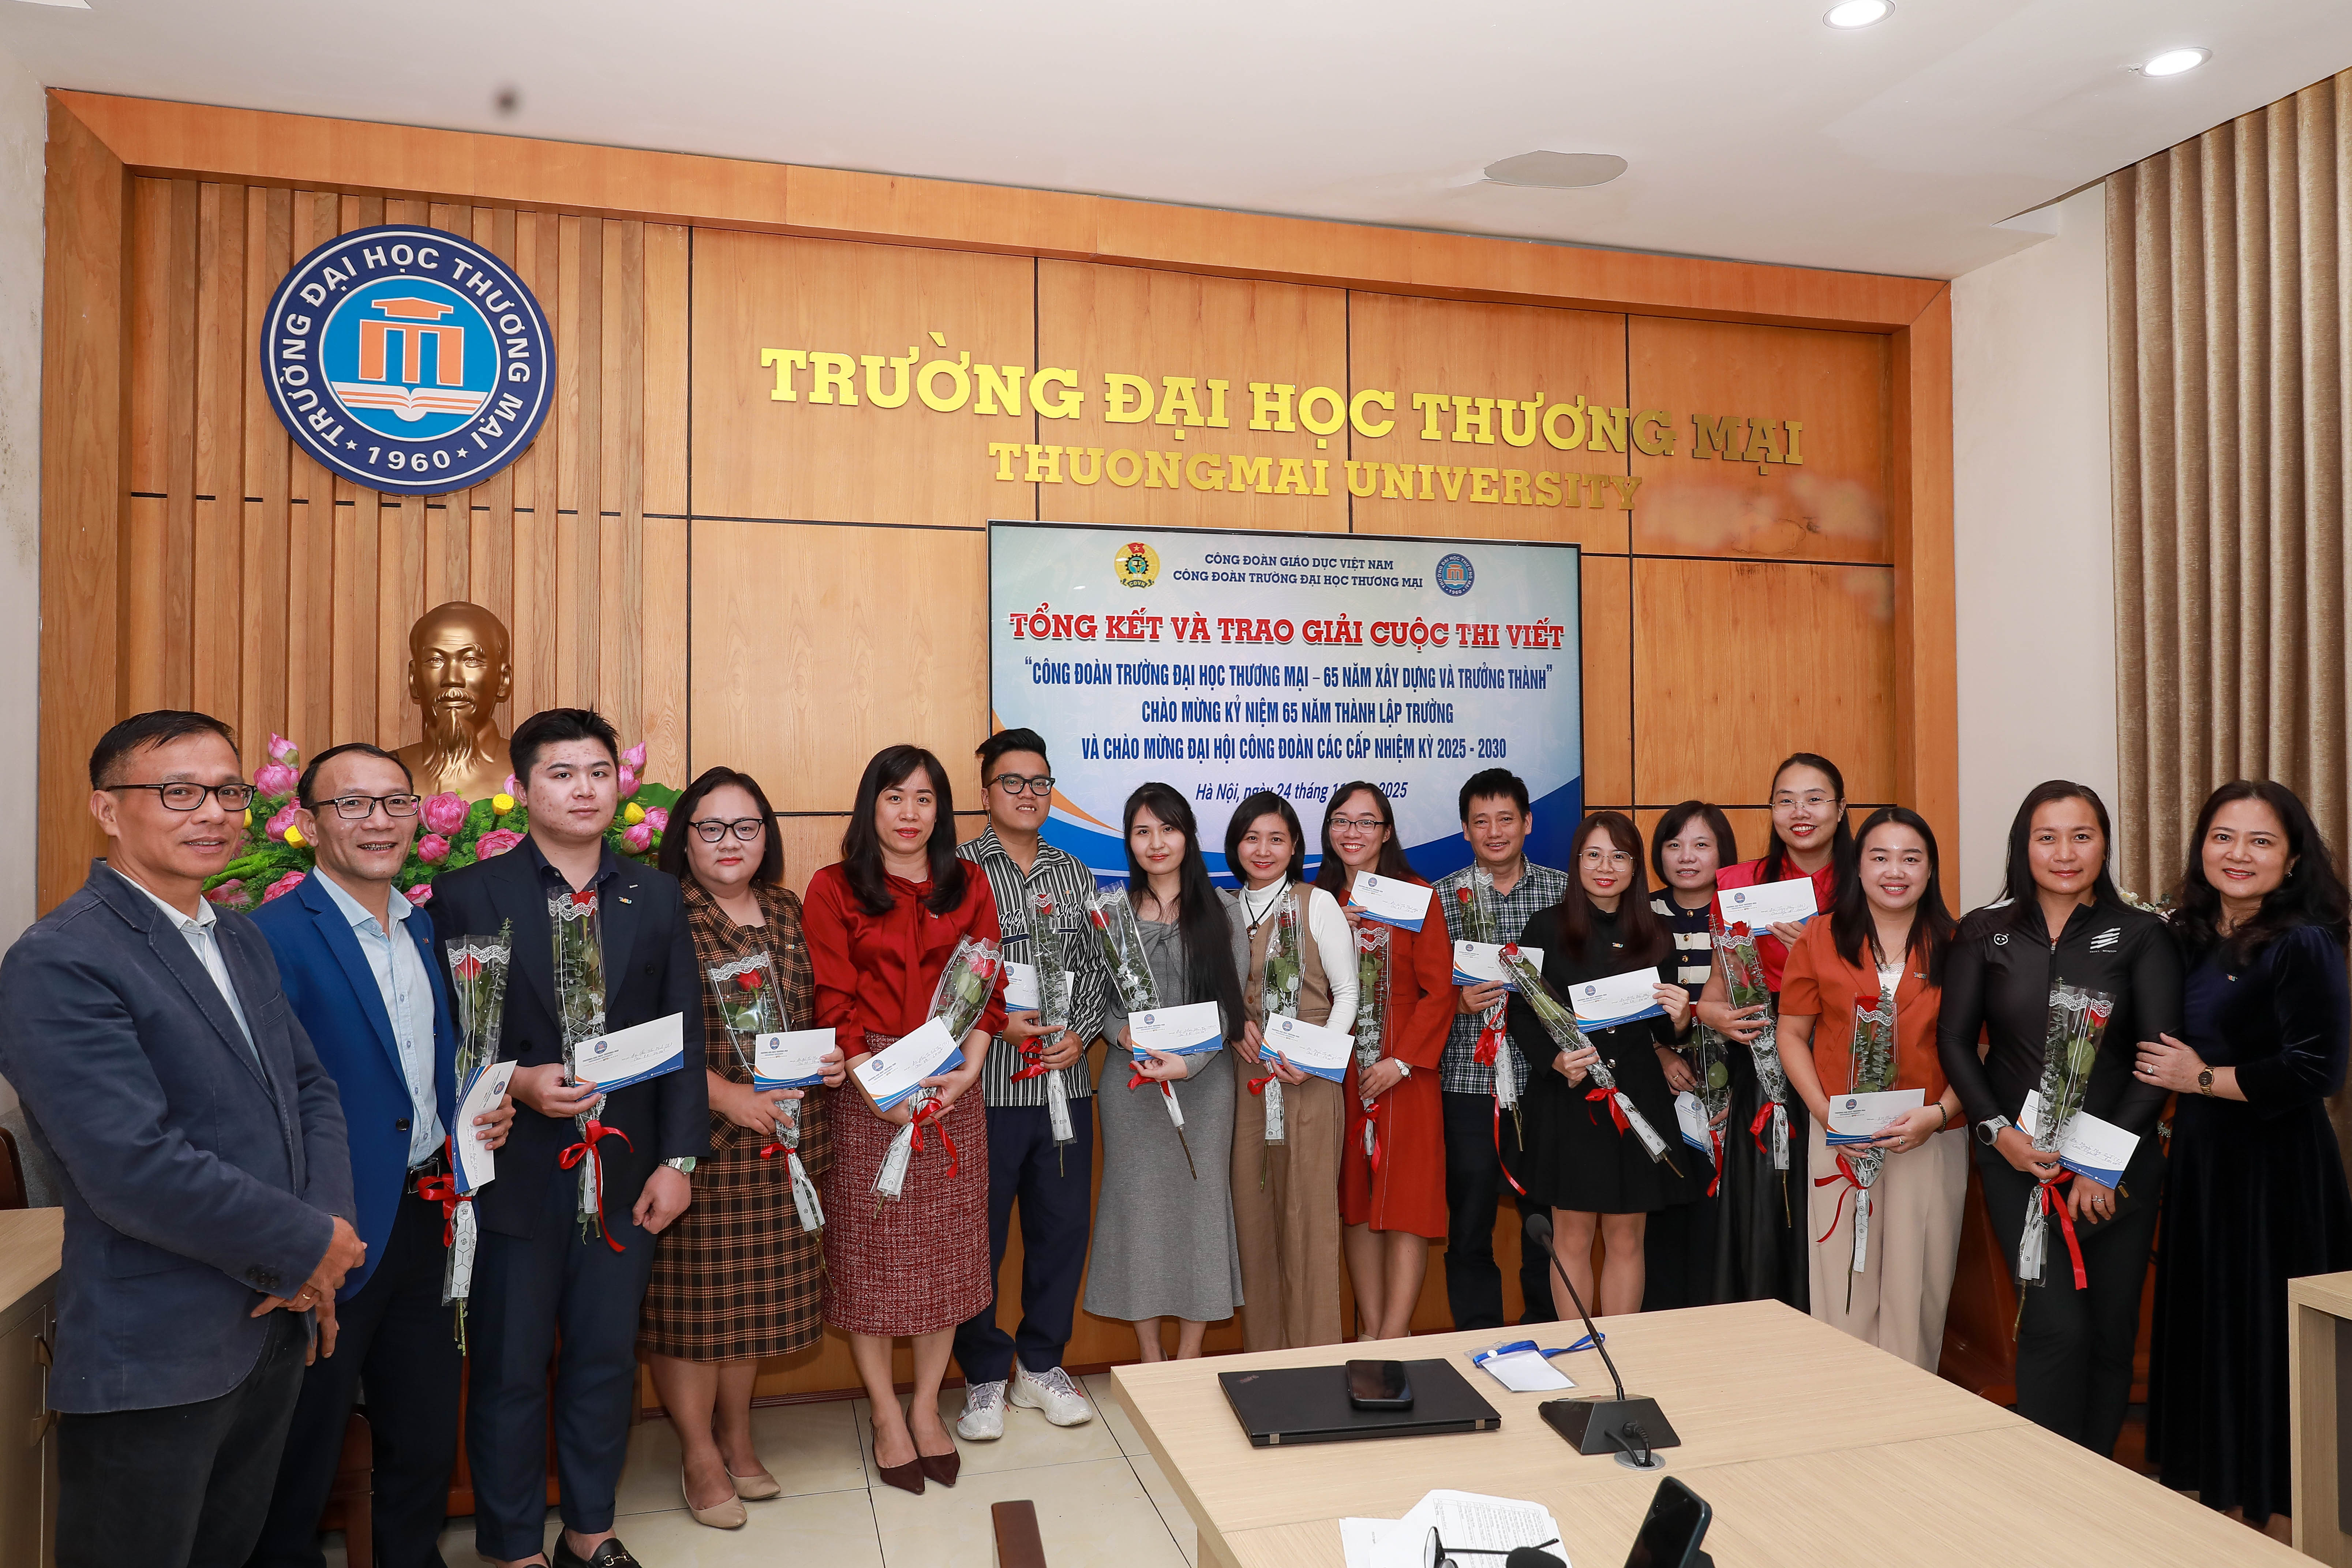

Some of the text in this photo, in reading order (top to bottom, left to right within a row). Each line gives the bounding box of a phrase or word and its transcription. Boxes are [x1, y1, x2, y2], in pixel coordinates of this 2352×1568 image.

[280, 244, 531, 450] TRƯỜNG ĐẠI HỌC THƯƠNG MẠI
[761, 332, 1804, 475] TRƯỜNG ĐẠI HỌC THƯƠNG MẠI
[368, 445, 450, 472] 1960
[989, 442, 1642, 510] THUONGMAI UNIVERSITY
[1205, 552, 1394, 571] CÔNG ĐOÀN GIÁO DỤC VIỆT NAM
[1173, 568, 1423, 590] CÔNG ĐOÀN TRƯỜNG ĐẠI HỌC THƯƠNG MẠI
[1010, 603, 1563, 650] TỔNG KẾT VÀ TRAO GIẢI CUỘC THI VIẾT
[1074, 658, 1112, 685] ĐOÀN
[1116, 658, 1169, 685] TRƯỜNG
[1173, 664, 1195, 691] ĐẠI
[1199, 665, 1225, 691] HỌC
[1229, 663, 1280, 687] THƯƠNG
[1284, 666, 1308, 692] MẠI
[1324, 666, 1338, 687] 65
[1342, 662, 1371, 688] NĂM
[1375, 663, 1399, 688] XÂY
[1402, 666, 1436, 693] DỰNG
[1439, 664, 1455, 688] VÀ
[1458, 662, 1505, 689] TRƯỞNG
[1142, 694, 1453, 728] CHÀO MỪNG KỶ NIỆM 65 NĂM THÀNH LẬP TRƯỜNG
[1082, 733, 1100, 759] VÀ
[1104, 733, 1139, 760] CHÀO
[1144, 733, 1183, 759] MỪNG
[1187, 738, 1209, 764] ĐẠI
[1214, 733, 1235, 764] HỘI
[1240, 733, 1274, 759] CÔNG
[1278, 733, 1313, 759] ĐOÀN
[1317, 733, 1342, 759] CÁC
[1346, 730, 1371, 759] CẤP
[1375, 734, 1415, 763] NHIỆM
[1419, 734, 1434, 758] KỲ
[1437, 738, 1466, 759] 2025
[1478, 738, 1506, 759] 2030
[1195, 783, 1213, 800] Hà
[1216, 783, 1239, 804] Nội,
[1244, 782, 1274, 799] nà
[1277, 782, 1292, 799] 24
[1295, 782, 1329, 803] tháng
[1379, 782, 1408, 798] 2025
